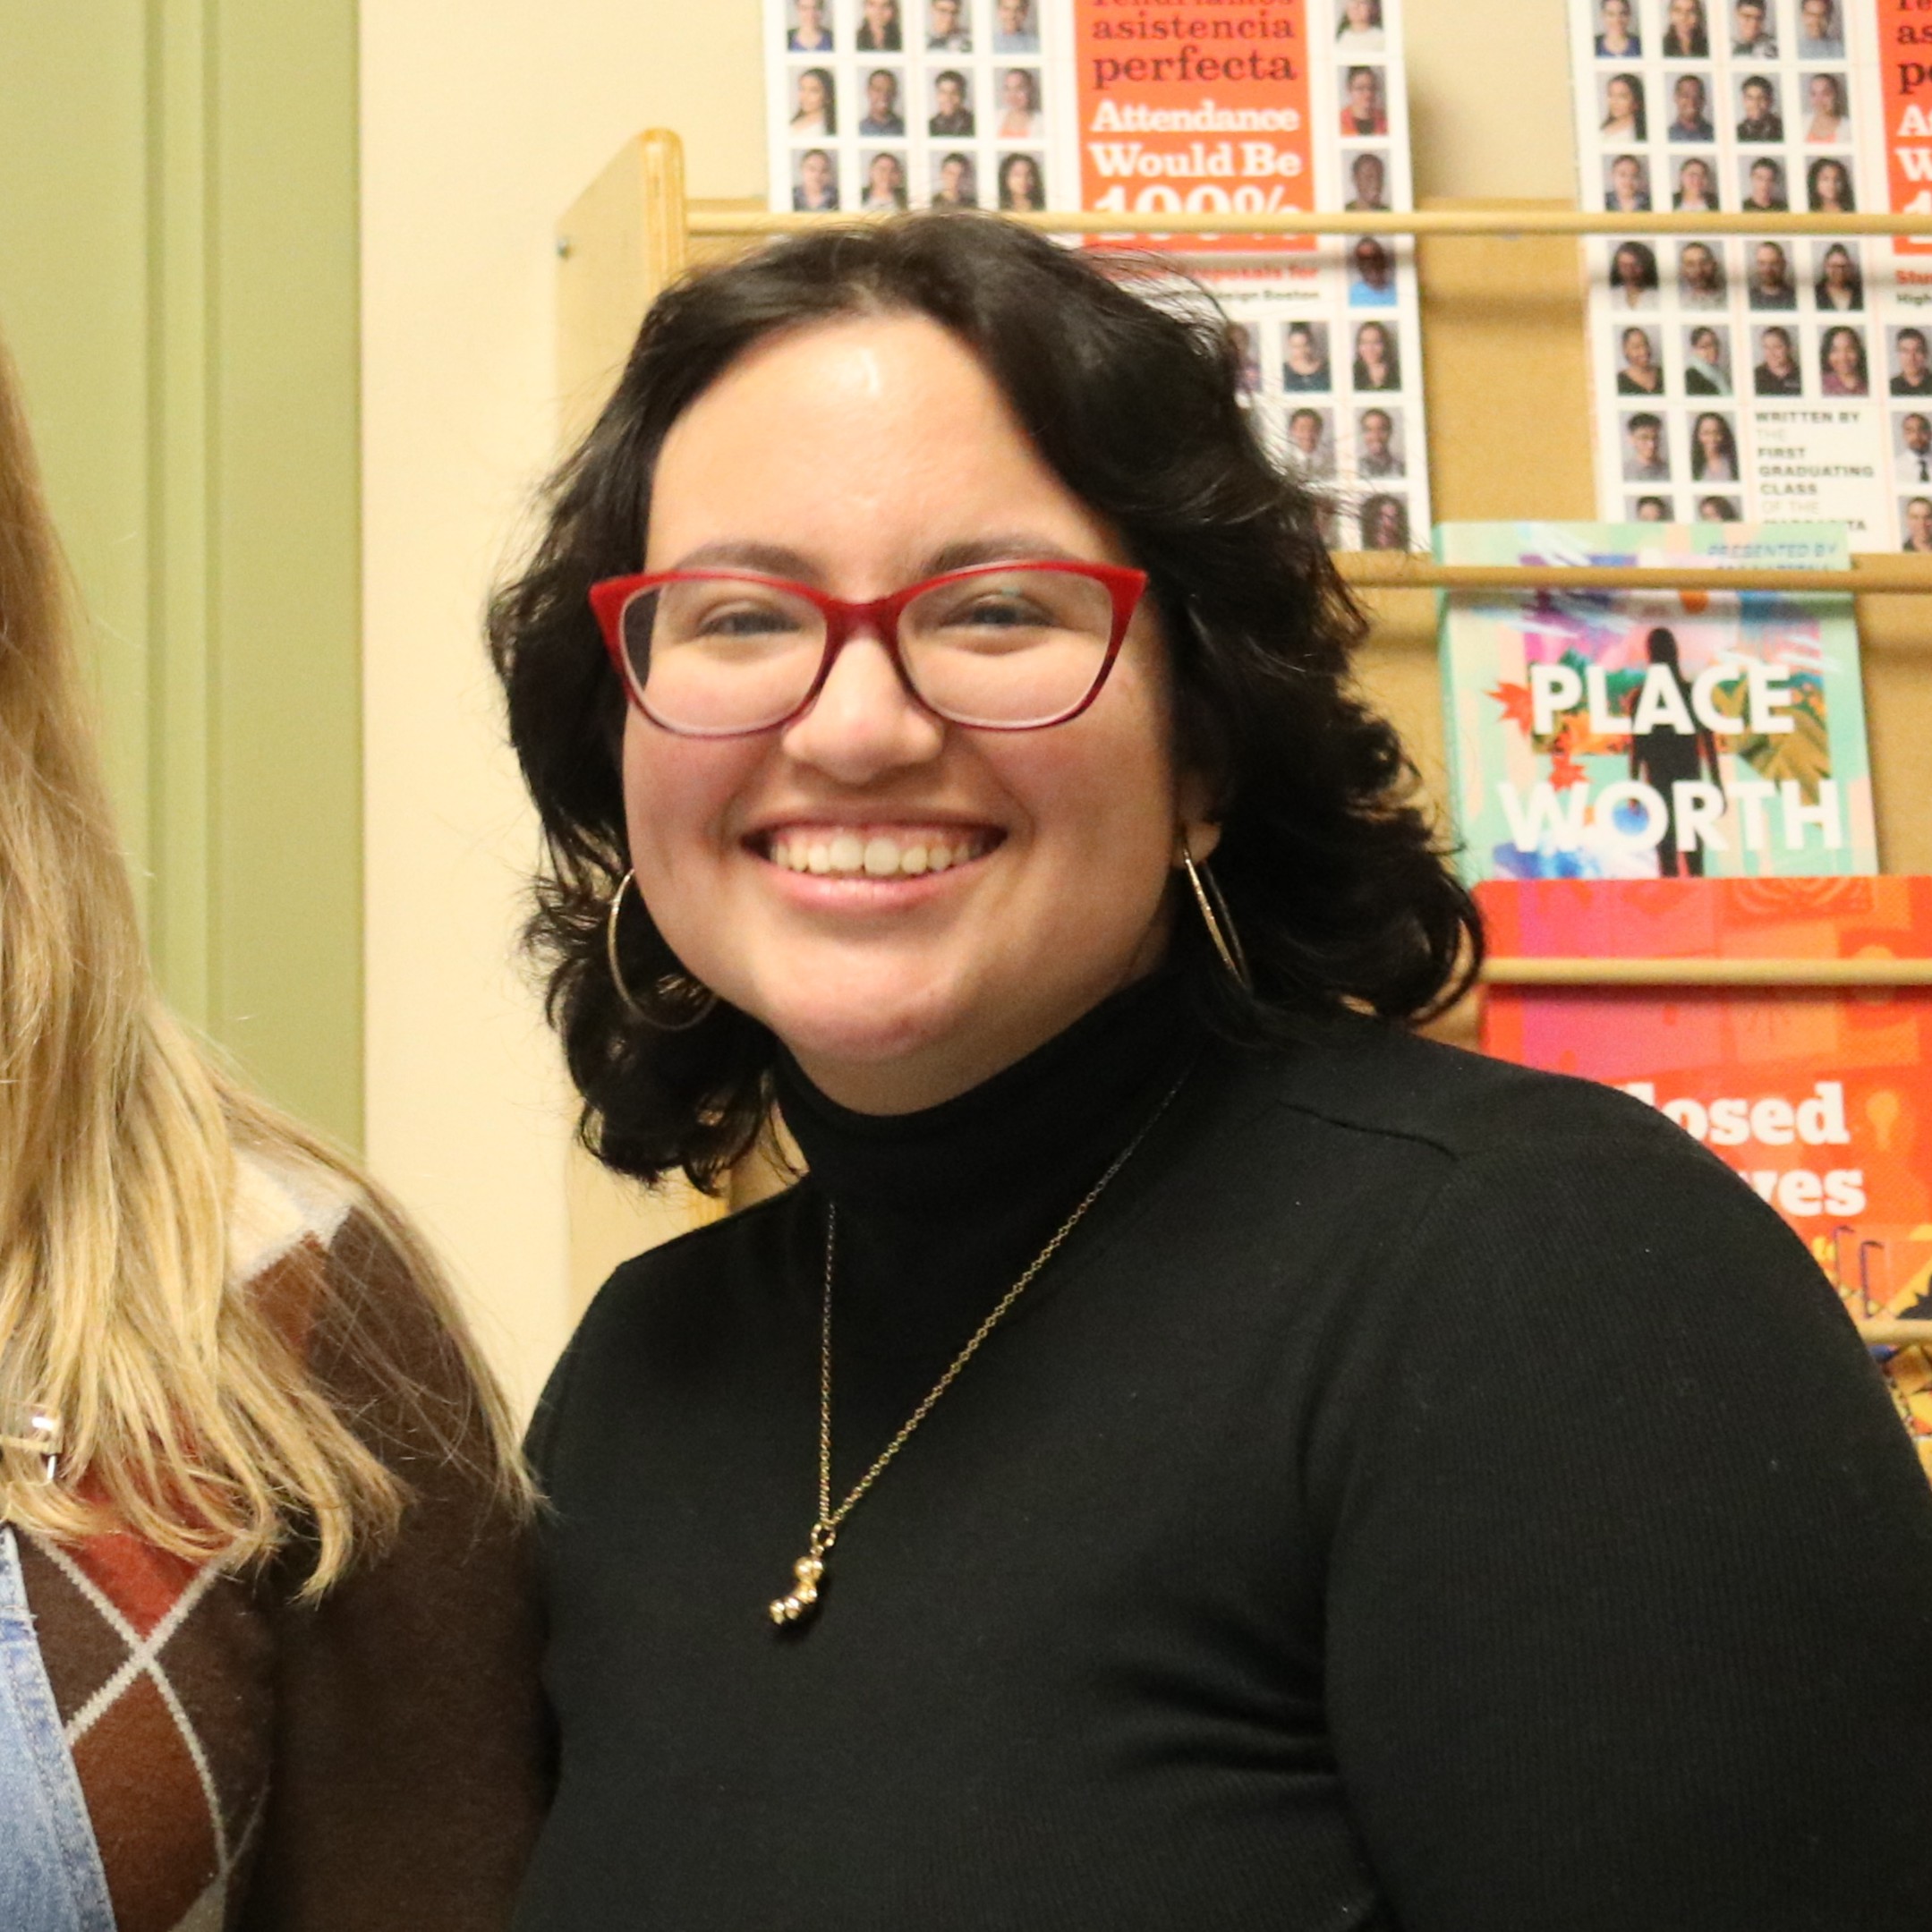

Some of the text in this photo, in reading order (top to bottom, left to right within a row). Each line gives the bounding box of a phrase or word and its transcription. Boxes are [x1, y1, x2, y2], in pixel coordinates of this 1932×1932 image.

[1093, 10, 1295, 40] asistencia
[1093, 45, 1297, 91] perfecta
[1090, 98, 1300, 132] Attendance
[1087, 141, 1302, 178] Would Be
[1755, 412, 1860, 422] WRITTEN BY
[1758, 447, 1806, 458] FIRST
[1758, 465, 1876, 477] GRADUATING
[1759, 483, 1817, 495] CLASS
[1531, 663, 1795, 736] PLACE
[1497, 779, 1843, 853] WORTH
